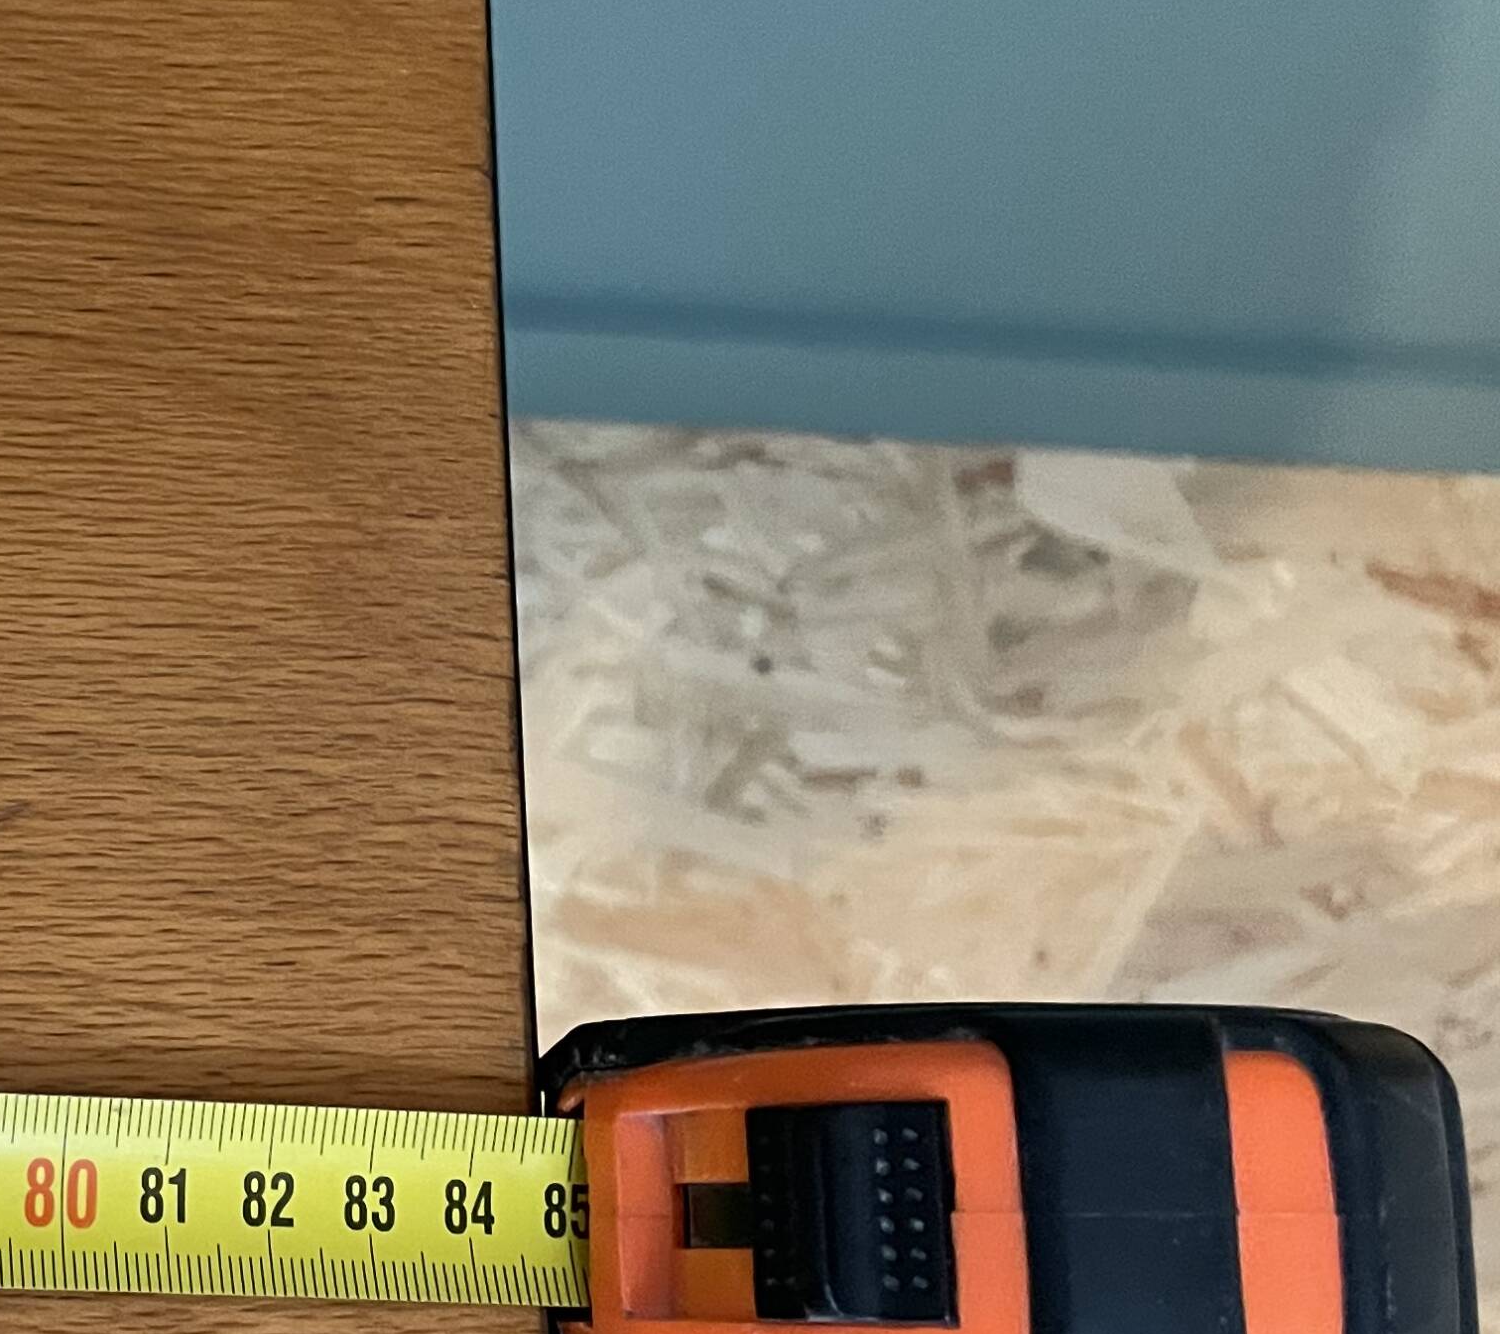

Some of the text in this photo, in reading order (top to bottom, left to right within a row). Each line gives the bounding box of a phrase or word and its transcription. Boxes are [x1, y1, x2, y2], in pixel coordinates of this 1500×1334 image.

[23, 1157, 98, 1229] 80
[139, 1166, 187, 1224] 81
[241, 1170, 295, 1228] 82
[344, 1174, 396, 1232] 83
[444, 1180, 495, 1236] 84
[543, 1182, 589, 1239] 85
